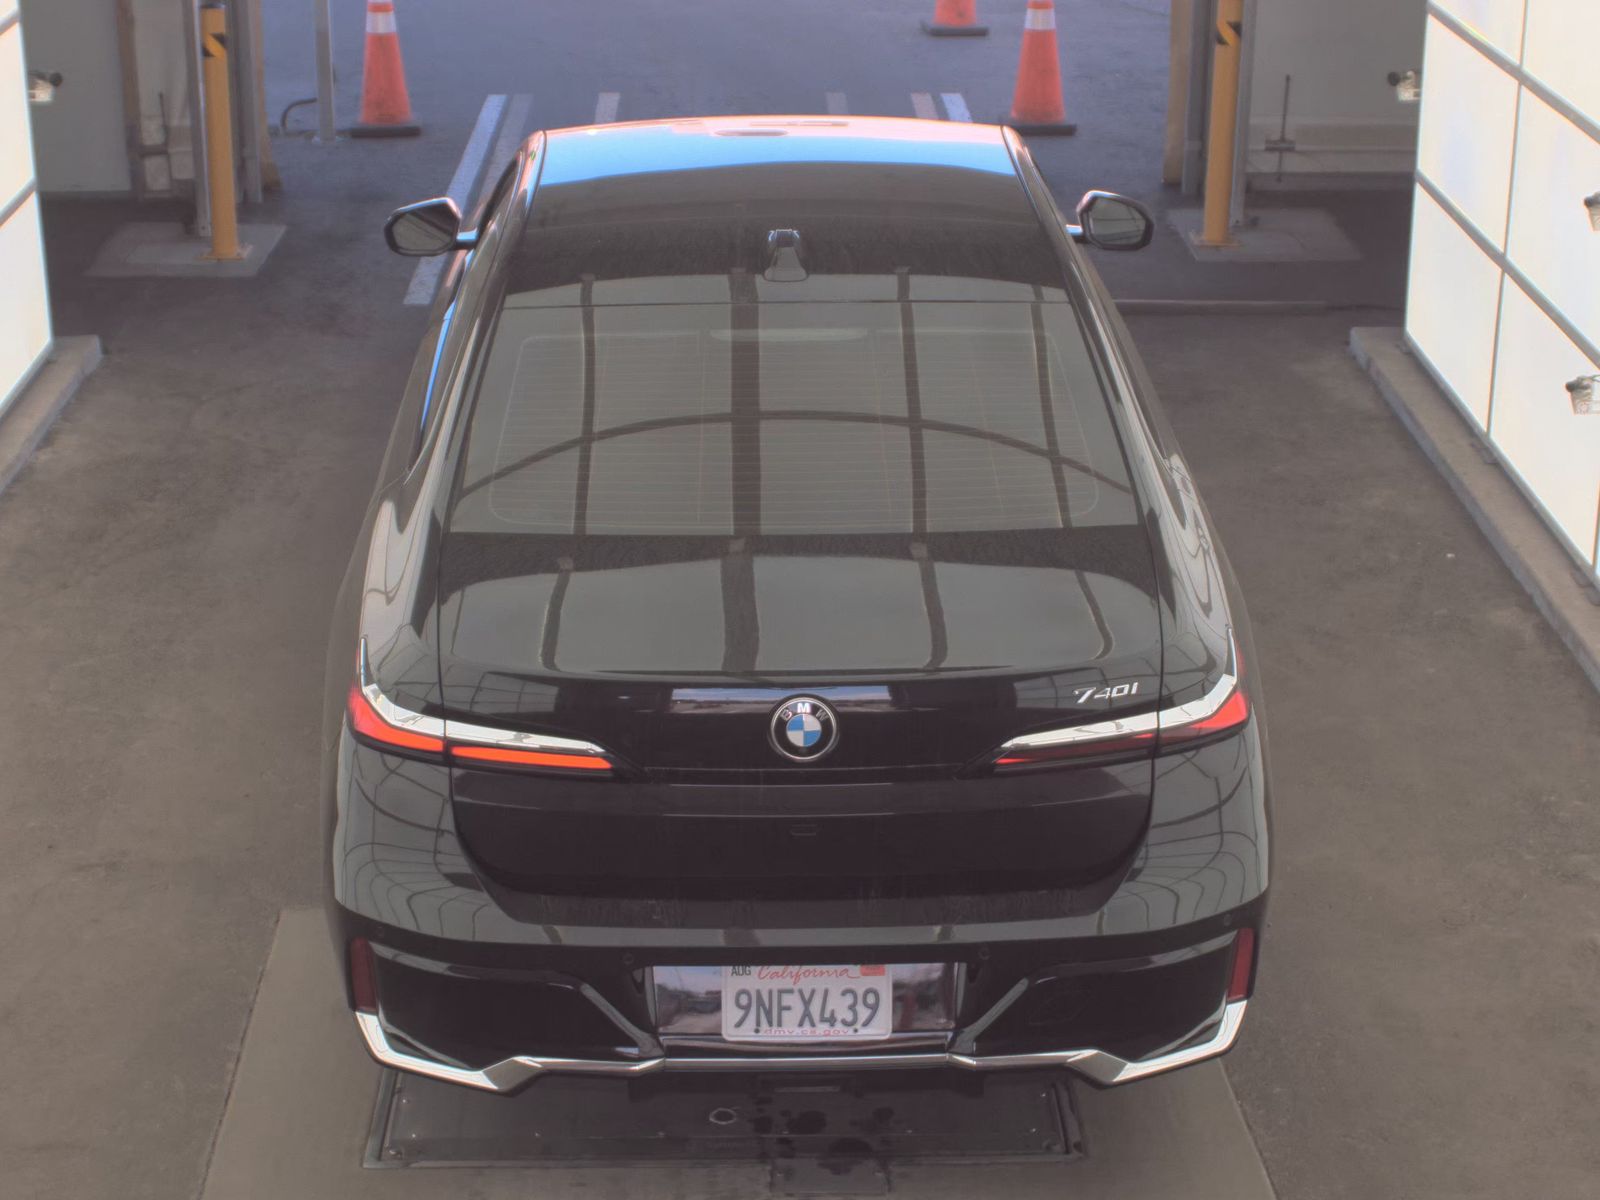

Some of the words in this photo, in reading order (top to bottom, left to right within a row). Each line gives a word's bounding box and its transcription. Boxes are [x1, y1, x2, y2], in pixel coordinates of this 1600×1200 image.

[780, 702, 830, 722] BMW
[731, 965, 751, 976] AUG
[757, 965, 860, 984] California
[734, 987, 880, 1028] 9NFX439
